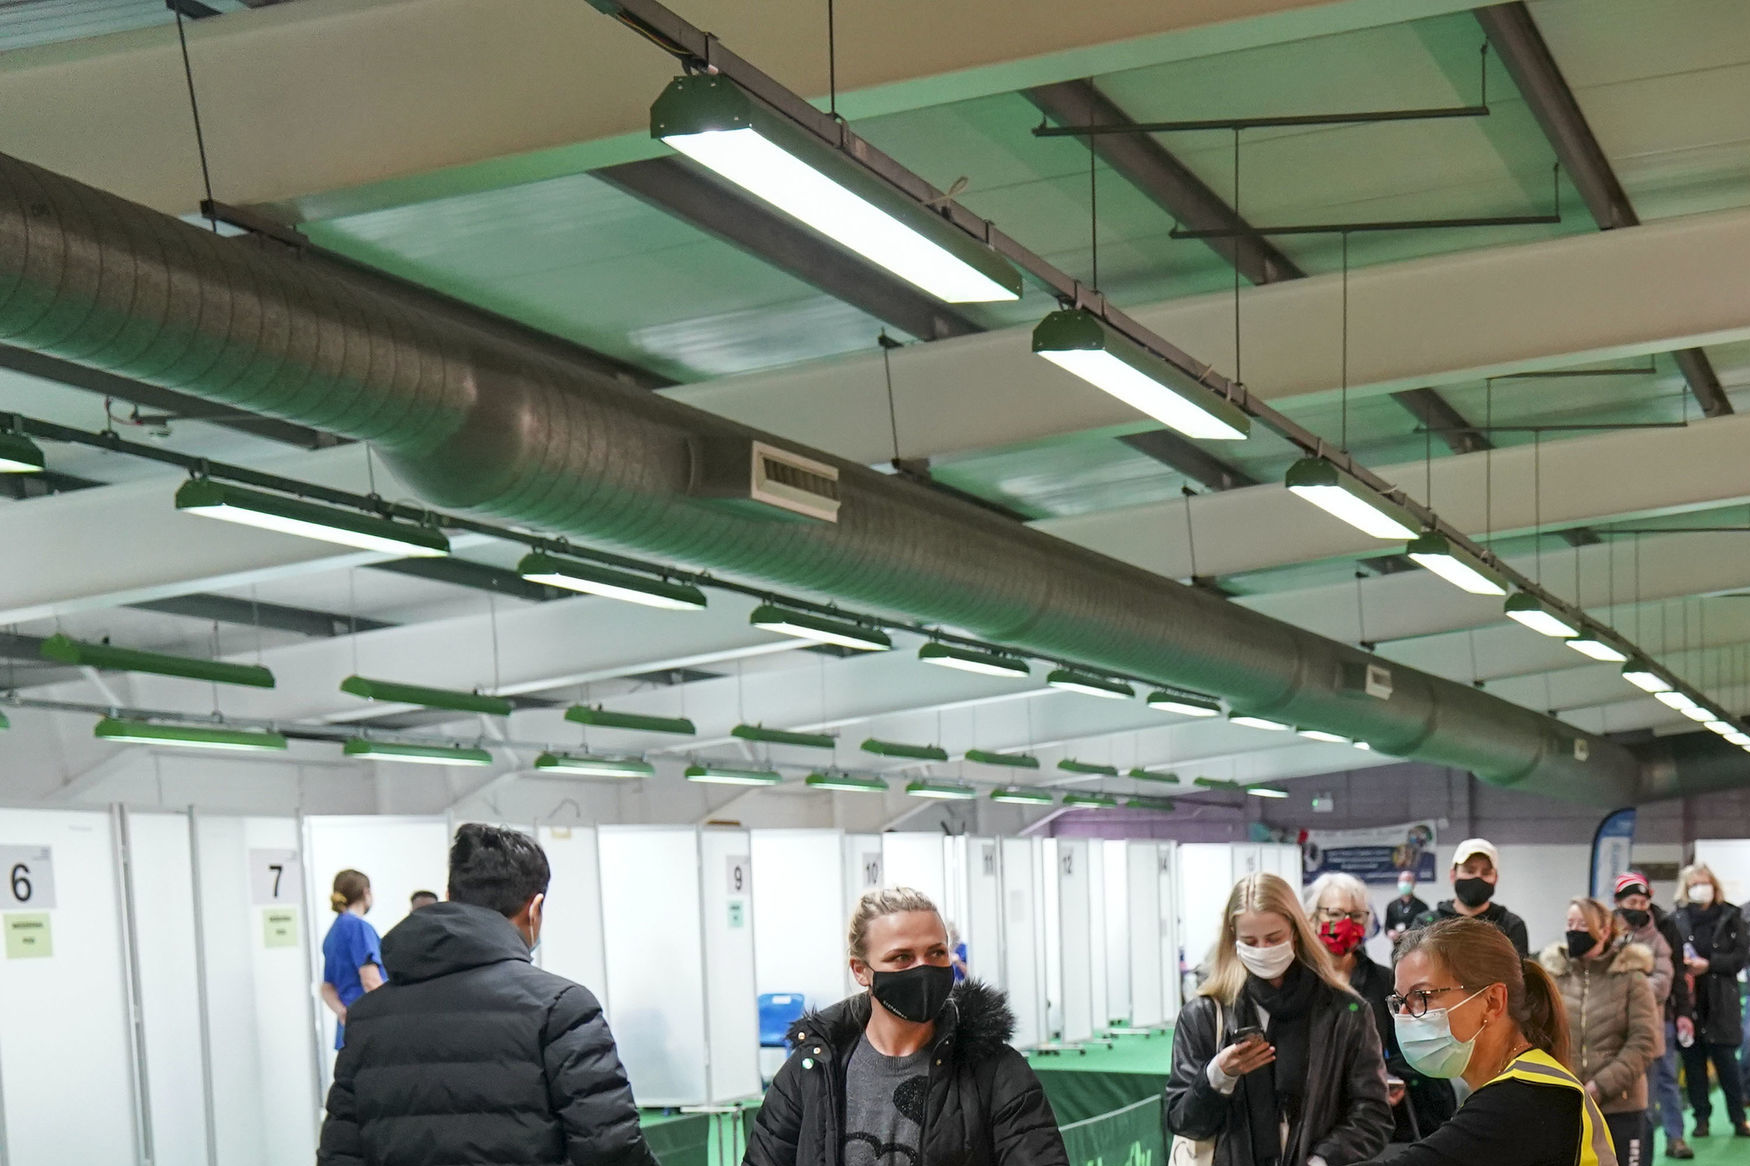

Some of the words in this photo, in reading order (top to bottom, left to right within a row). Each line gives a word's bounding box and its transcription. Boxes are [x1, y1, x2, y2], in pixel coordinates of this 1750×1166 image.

[865, 861, 879, 885] 10
[984, 854, 994, 875] 11
[1062, 854, 1073, 875] 12
[11, 863, 32, 902] 6
[269, 864, 283, 898] 7
[734, 866, 743, 891] 9
